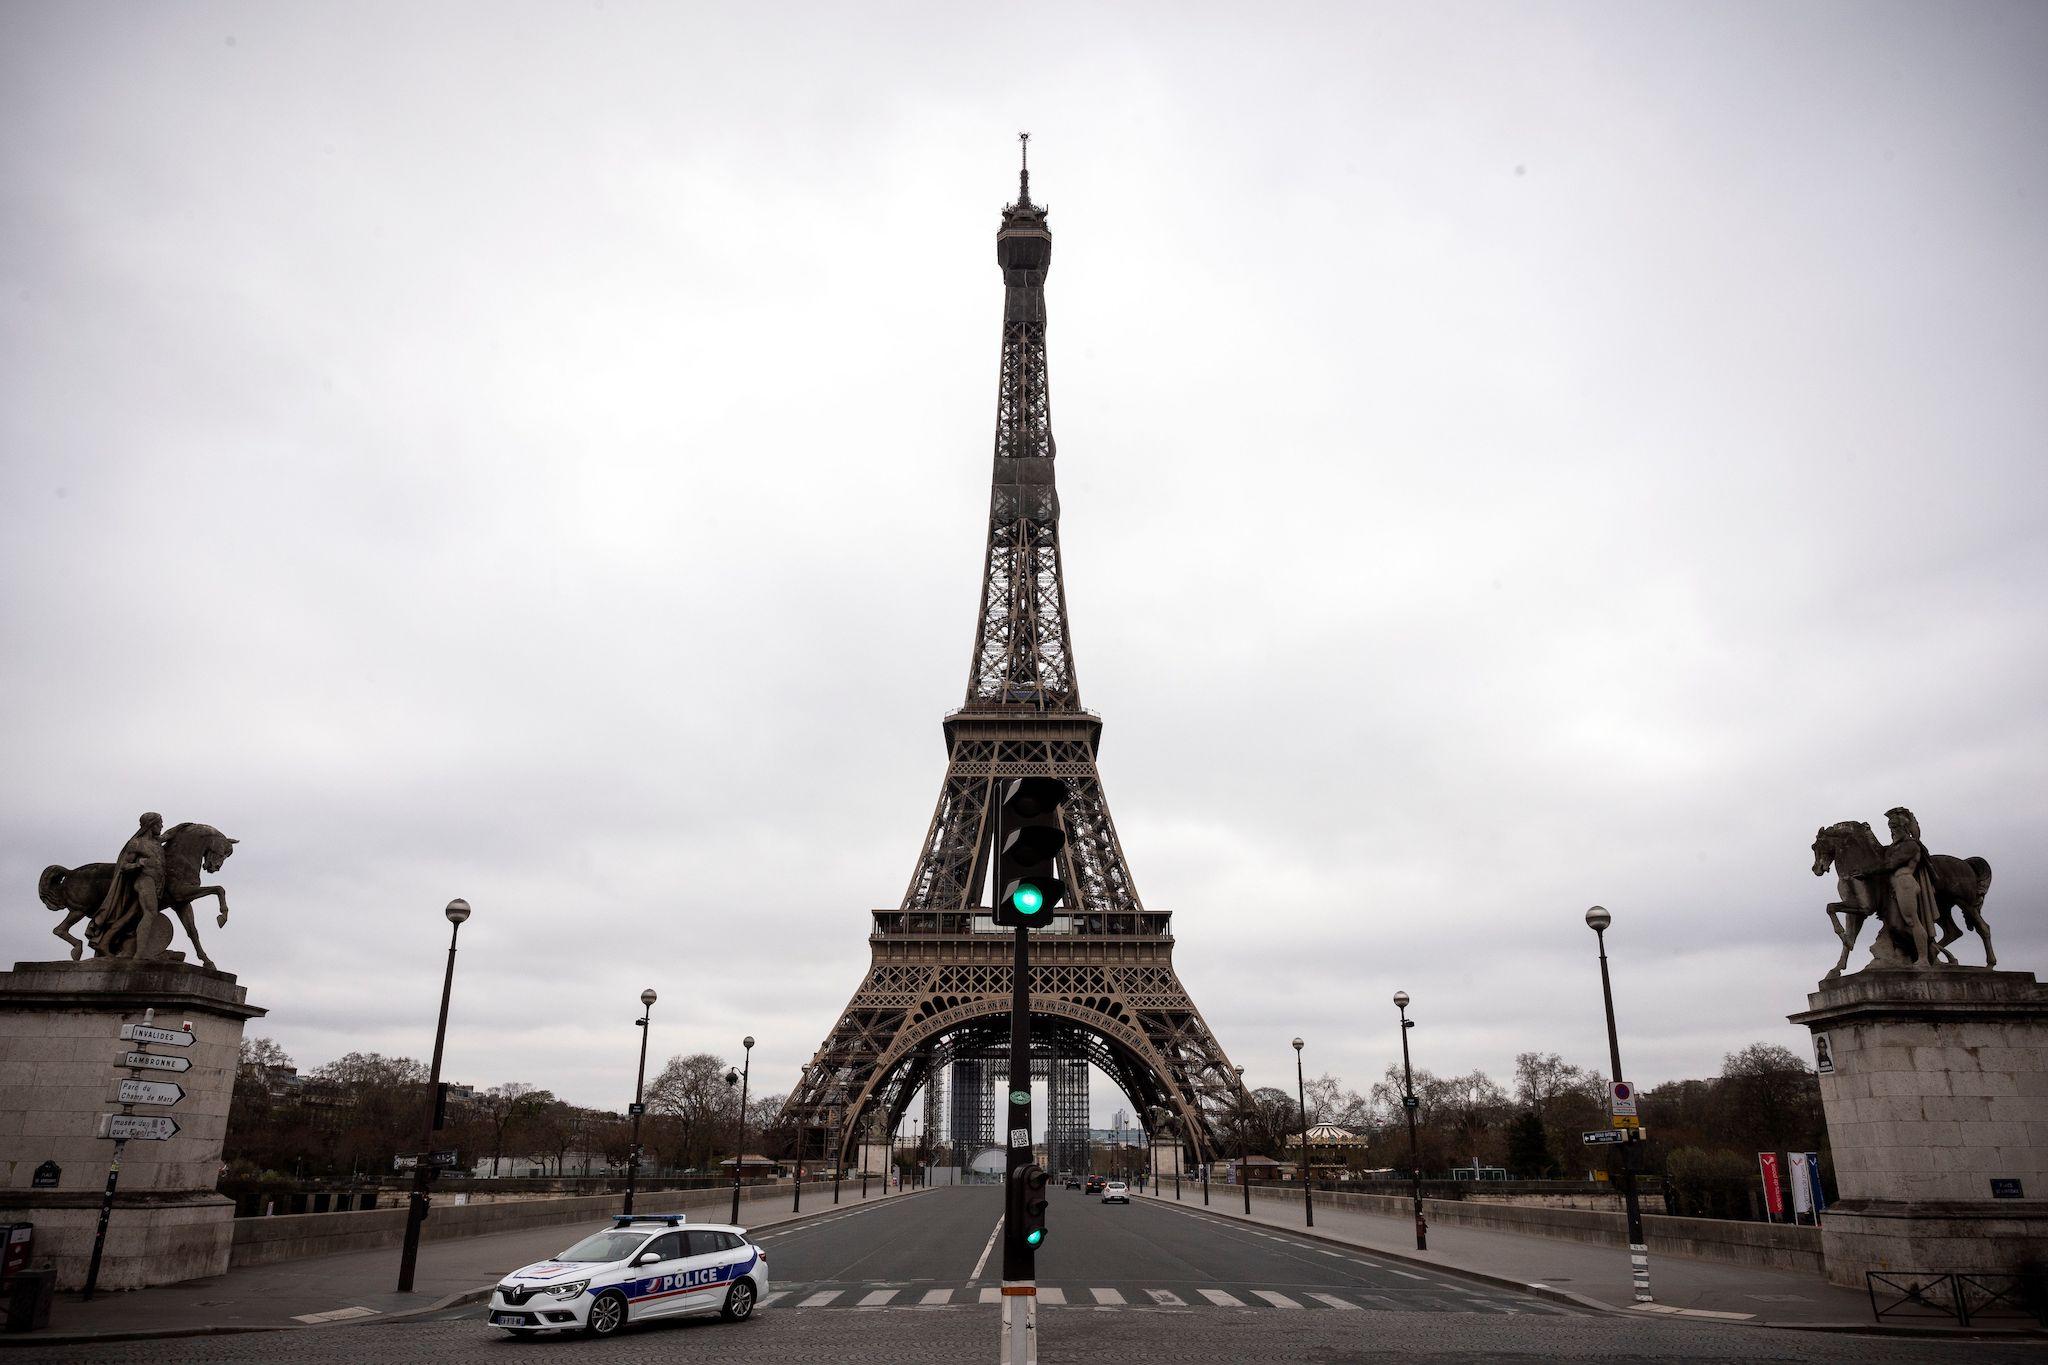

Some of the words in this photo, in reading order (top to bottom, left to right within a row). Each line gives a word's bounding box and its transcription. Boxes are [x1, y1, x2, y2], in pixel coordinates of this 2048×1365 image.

[134, 1029, 174, 1041] INVALIDES
[128, 1056, 176, 1068] CAMBRONNE
[122, 1082, 139, 1091] Parc
[142, 1084, 151, 1092] du
[121, 1092, 144, 1102] Champ
[146, 1094, 155, 1102] de
[156, 1095, 173, 1103] Mars
[663, 1267, 718, 1290] POLICE
